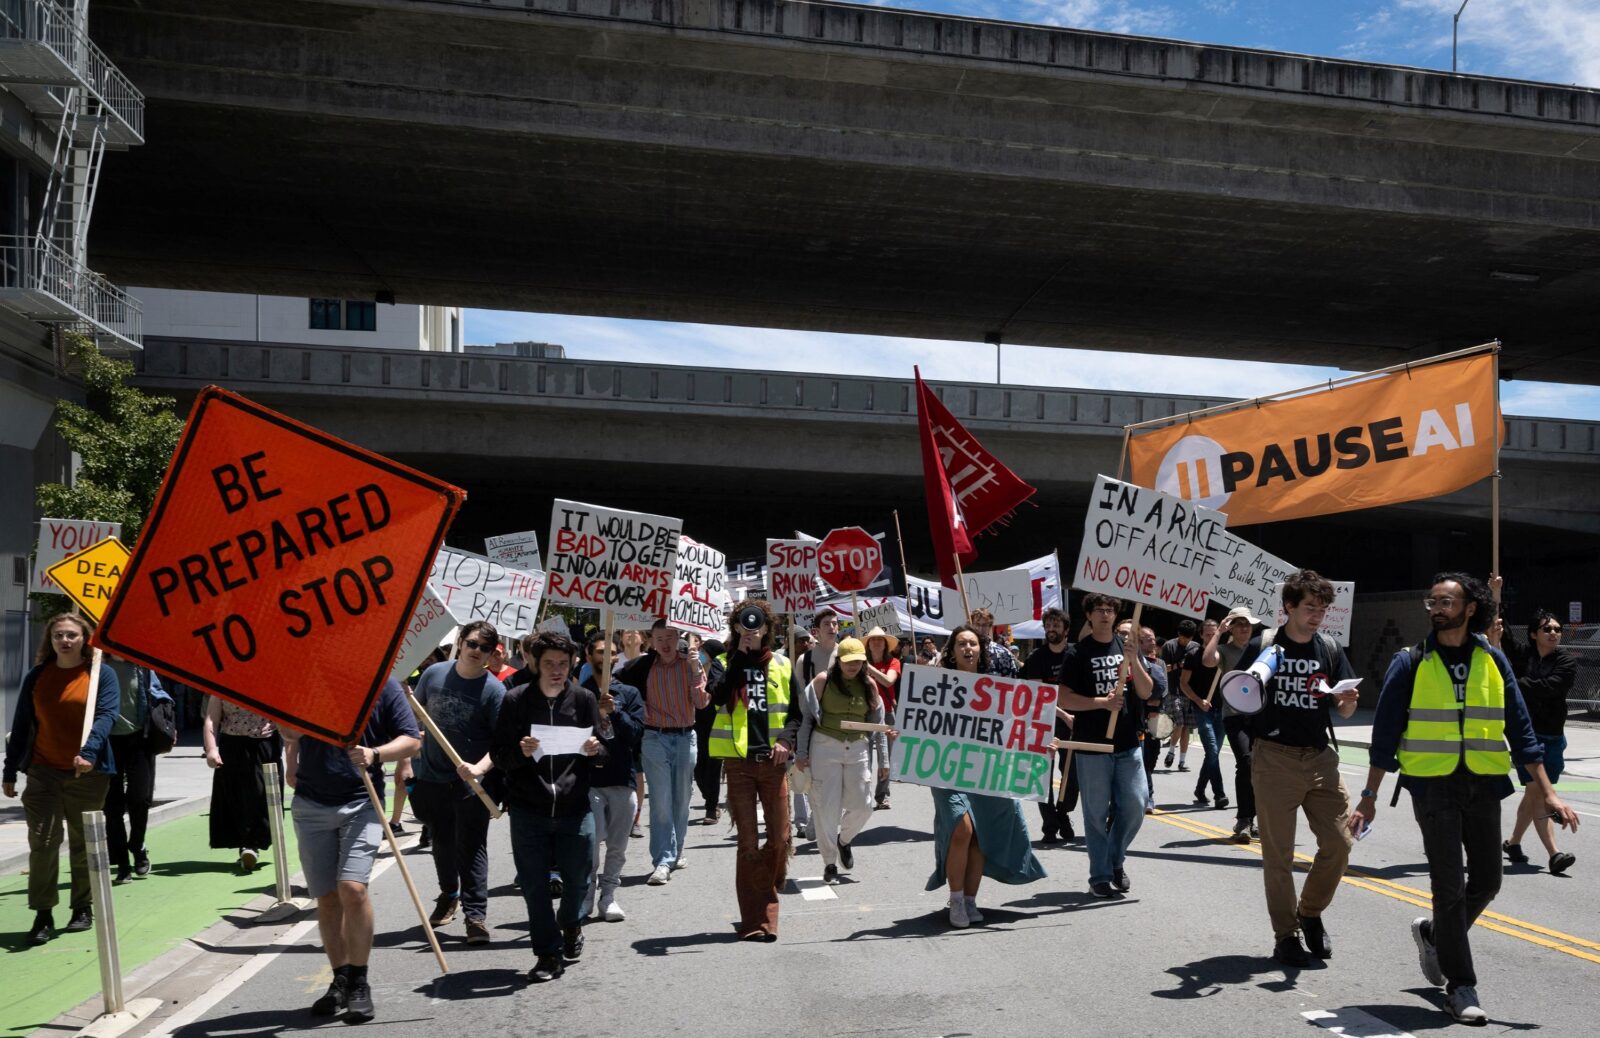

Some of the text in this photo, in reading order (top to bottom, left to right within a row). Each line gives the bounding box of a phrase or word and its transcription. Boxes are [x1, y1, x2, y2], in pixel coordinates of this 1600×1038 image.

[211, 451, 282, 514] BE
[561, 509, 589, 531] IT
[596, 514, 654, 541] WOULD
[654, 526, 680, 549] BE
[1099, 483, 1222, 551] IN A RACE
[49, 522, 114, 550] YOU'
[149, 483, 391, 617] PREPARED
[556, 529, 606, 558] BAD
[608, 540, 636, 563] TO
[638, 545, 676, 568] GET
[1096, 519, 1216, 576] OFF A CLIFF
[77, 560, 122, 578] DEA
[678, 546, 723, 569] WOULD
[769, 543, 816, 568] STOP
[820, 546, 879, 574] STOP
[1220, 536, 1290, 582] IF Anyone
[551, 553, 596, 578] INTO
[597, 560, 618, 580] AN
[619, 563, 672, 588] ARMS
[676, 563, 723, 592] MAKE US
[1084, 556, 1209, 612] NO ONE WINS
[1228, 561, 1276, 596] Builds It
[82, 583, 112, 600] EN
[509, 572, 543, 600] THE
[548, 572, 671, 619] RACE OVER AI
[680, 583, 718, 608] ALL
[772, 572, 816, 600] RACING
[193, 554, 394, 672] TO STOP
[470, 592, 531, 631] RACE
[669, 599, 722, 631] HOMELESS
[785, 596, 816, 612] NOW
[877, 604, 895, 616] CAN
[994, 592, 1020, 614] AI
[1257, 598, 1274, 618] Die
[1091, 654, 1124, 668] STOP
[1093, 668, 1118, 681] THE
[1277, 659, 1320, 674] STOP
[744, 669, 765, 682] TO
[1274, 676, 1308, 691] THE
[747, 684, 766, 697] HE
[907, 671, 1057, 720] Let's STOP
[1274, 691, 1318, 709] RACE
[748, 699, 767, 711] AC
[903, 708, 1052, 754] FRONTIER AI
[900, 736, 1049, 796] TOGETHER
